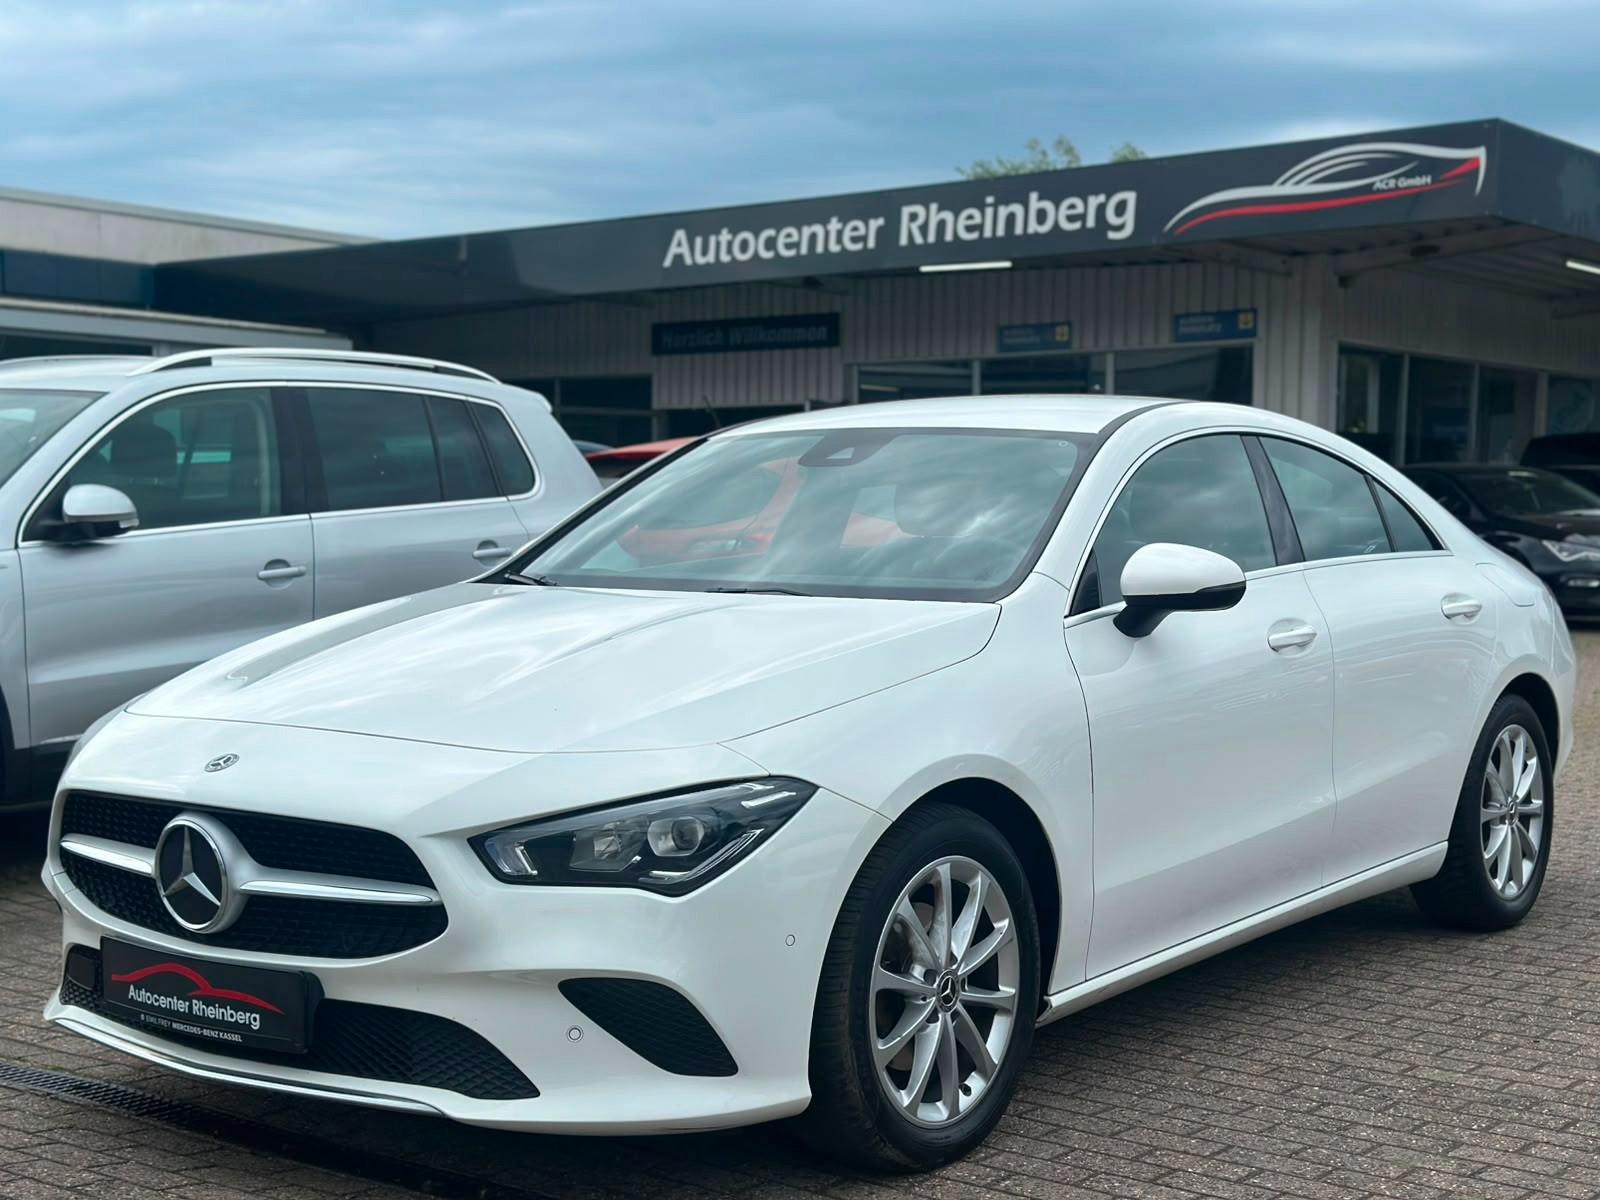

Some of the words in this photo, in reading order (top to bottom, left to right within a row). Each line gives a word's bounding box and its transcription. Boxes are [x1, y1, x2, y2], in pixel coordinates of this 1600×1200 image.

[1372, 178, 1396, 192] ACR
[1397, 174, 1432, 188] GmbH
[662, 213, 885, 269] Autocenter
[898, 190, 1138, 241] Rheinberg
[128, 984, 190, 1014] Autocenter
[192, 999, 261, 1030] Rheinberg
[172, 1022, 218, 1038] MERCEDES-BENZ
[219, 1031, 243, 1042] KASSEL
